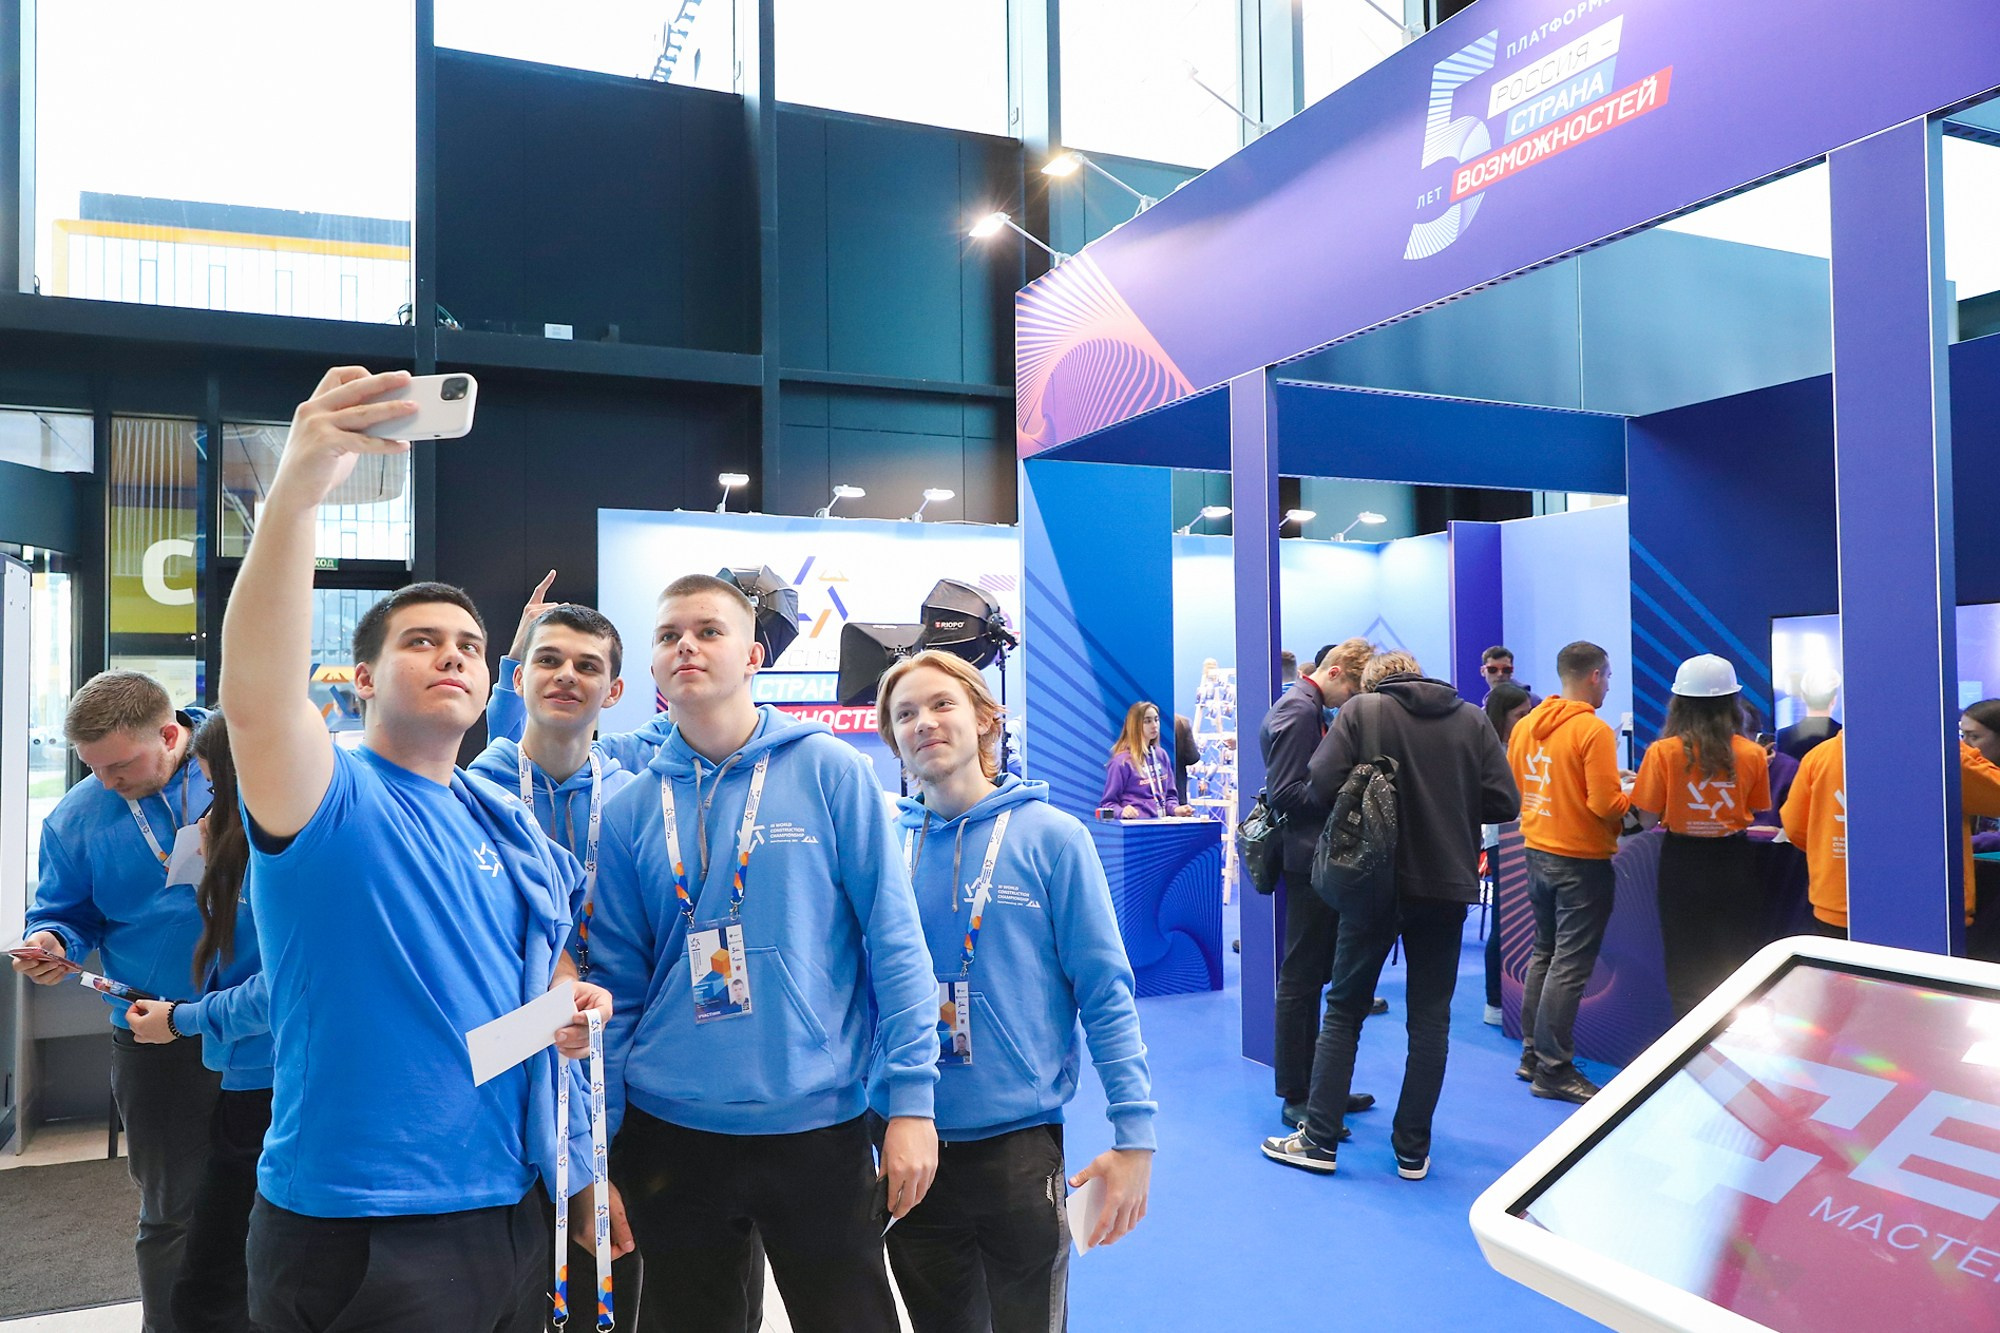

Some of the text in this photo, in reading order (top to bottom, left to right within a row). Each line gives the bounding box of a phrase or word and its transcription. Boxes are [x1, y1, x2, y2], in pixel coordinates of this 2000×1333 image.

[1506, 0, 1612, 59] ПЛАТФОРМ
[1496, 41, 1590, 108] РОССИЯ
[1510, 71, 1605, 136] СТРАНА
[1456, 75, 1658, 195] ВОЗМОЖНОСТЕЙ
[1416, 187, 1443, 210] ЛЕТ
[315, 559, 334, 568] ХОД
[756, 677, 839, 700] СТРАН
[1809, 1195, 2000, 1283] МАСТЕ
